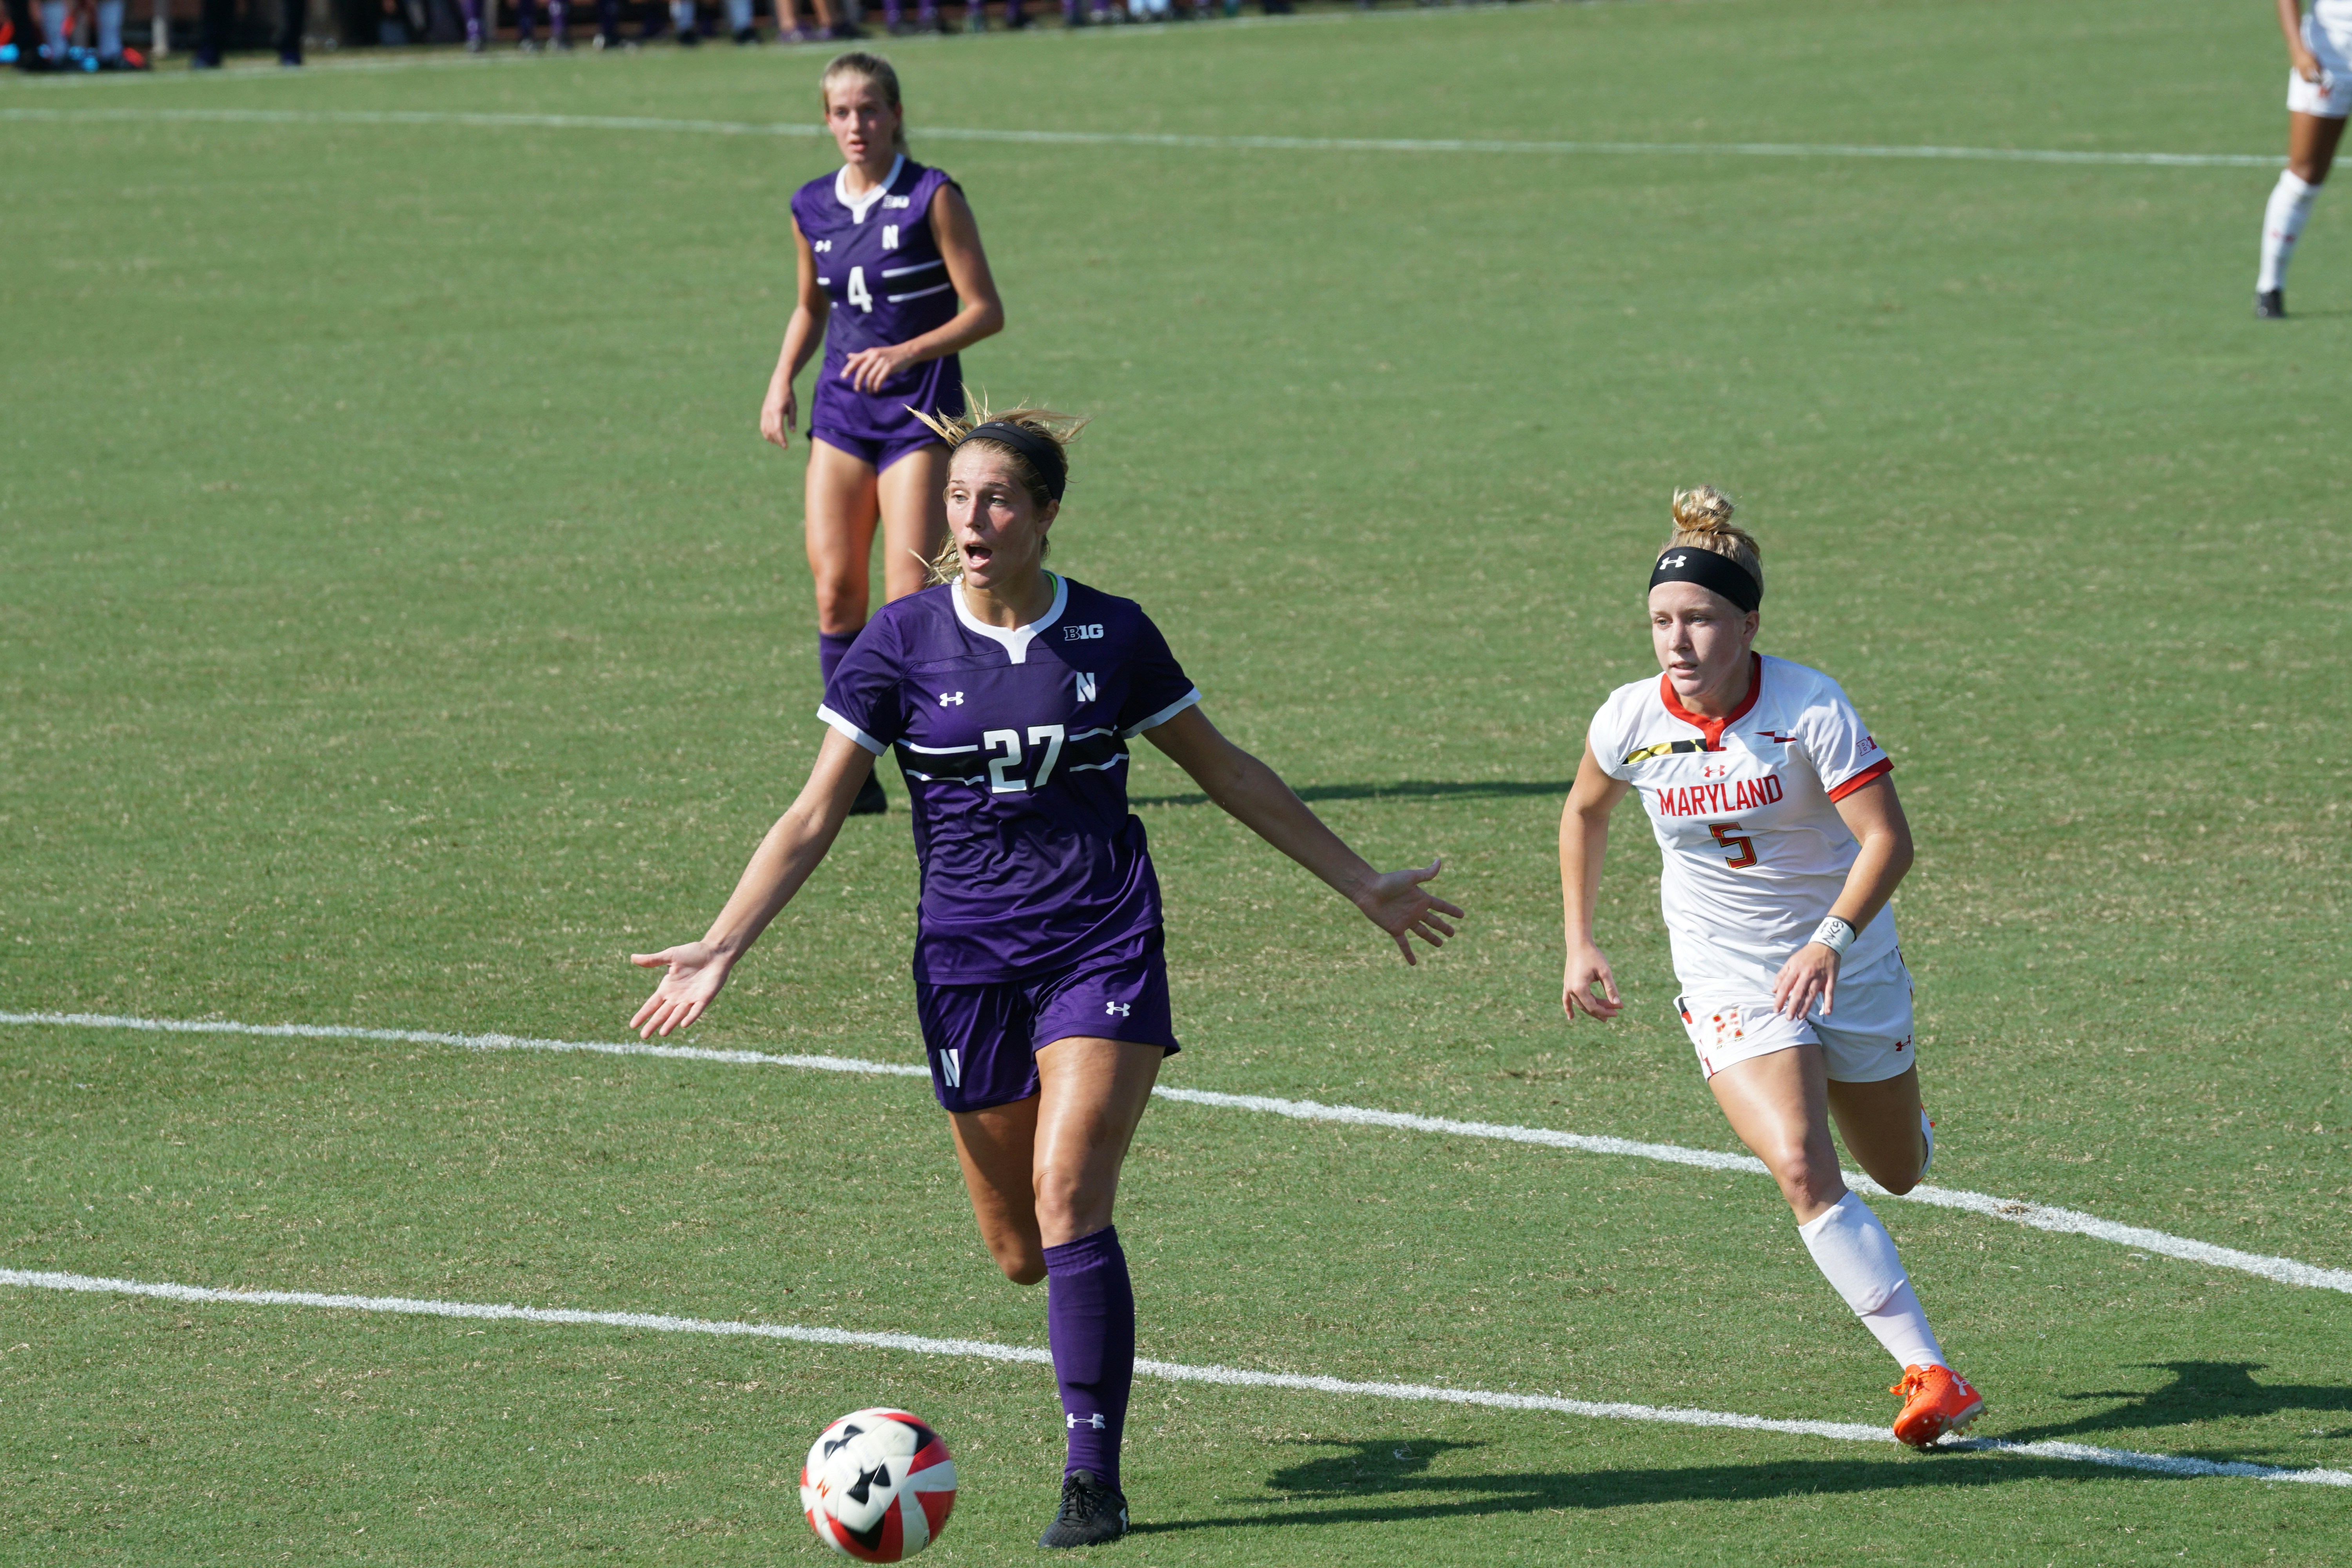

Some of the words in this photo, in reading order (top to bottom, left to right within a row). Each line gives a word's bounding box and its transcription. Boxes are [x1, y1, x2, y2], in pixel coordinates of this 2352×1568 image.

[882, 225, 899, 250] N
[848, 266, 872, 312] 4
[1076, 672, 1096, 702] N
[983, 724, 1065, 793] 27
[1657, 774, 1782, 817] MARYLAND
[1708, 822, 1757, 869] 5
[939, 1049, 960, 1088] N
